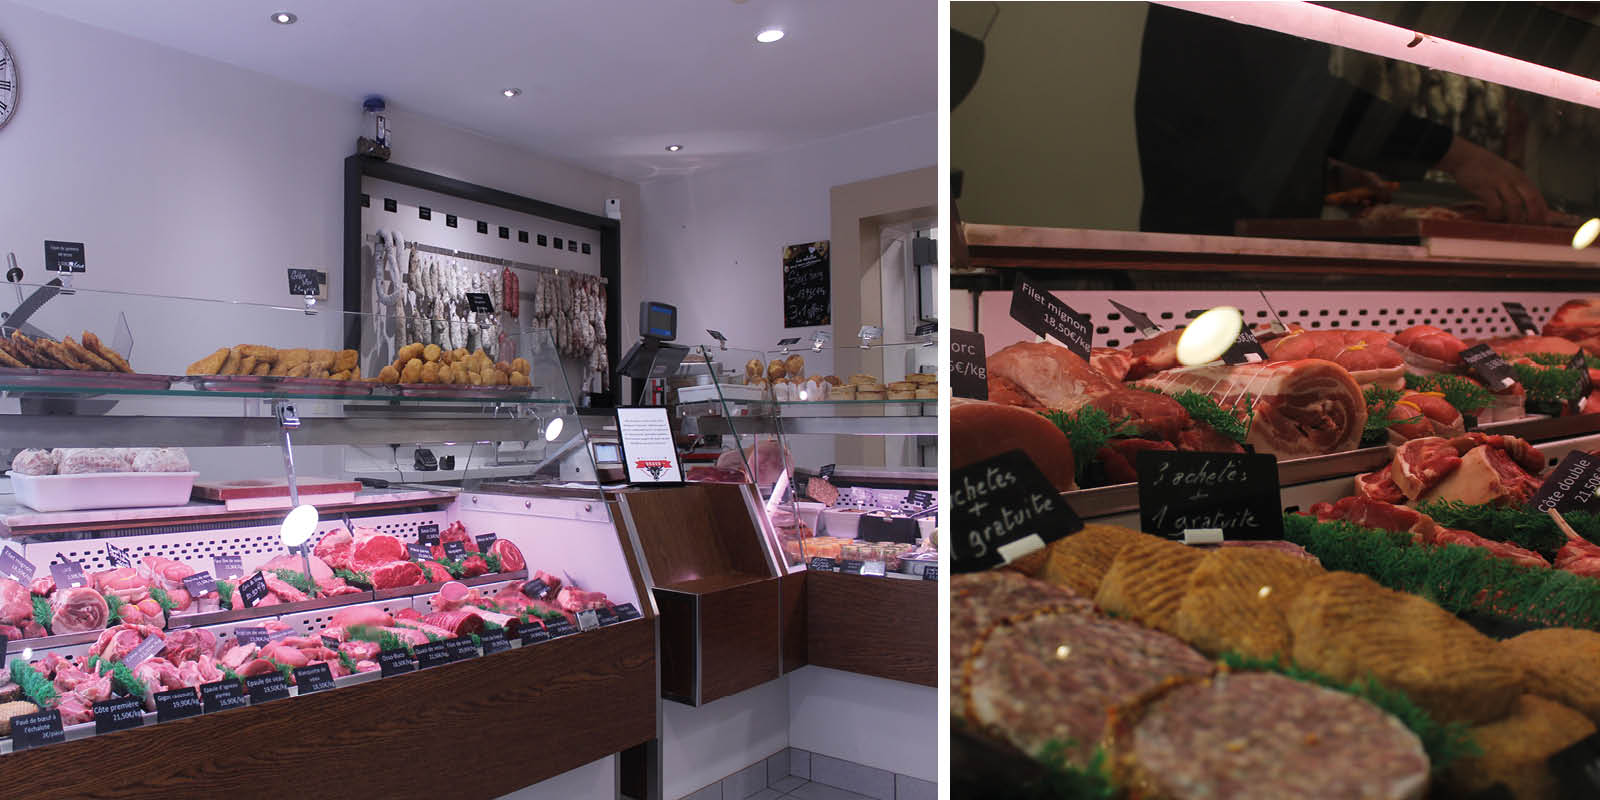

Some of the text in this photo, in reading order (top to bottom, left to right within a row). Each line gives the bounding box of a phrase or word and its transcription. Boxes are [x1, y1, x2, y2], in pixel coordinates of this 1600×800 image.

[1022, 282, 1088, 334] Filet mignon
[1043, 313, 1091, 353] 18,50€/kg
[1538, 459, 1591, 513] Côte double
[969, 493, 1055, 558] gratuite
[1152, 505, 1260, 536] 1 gratuite
[94, 700, 140, 714] Côte première
